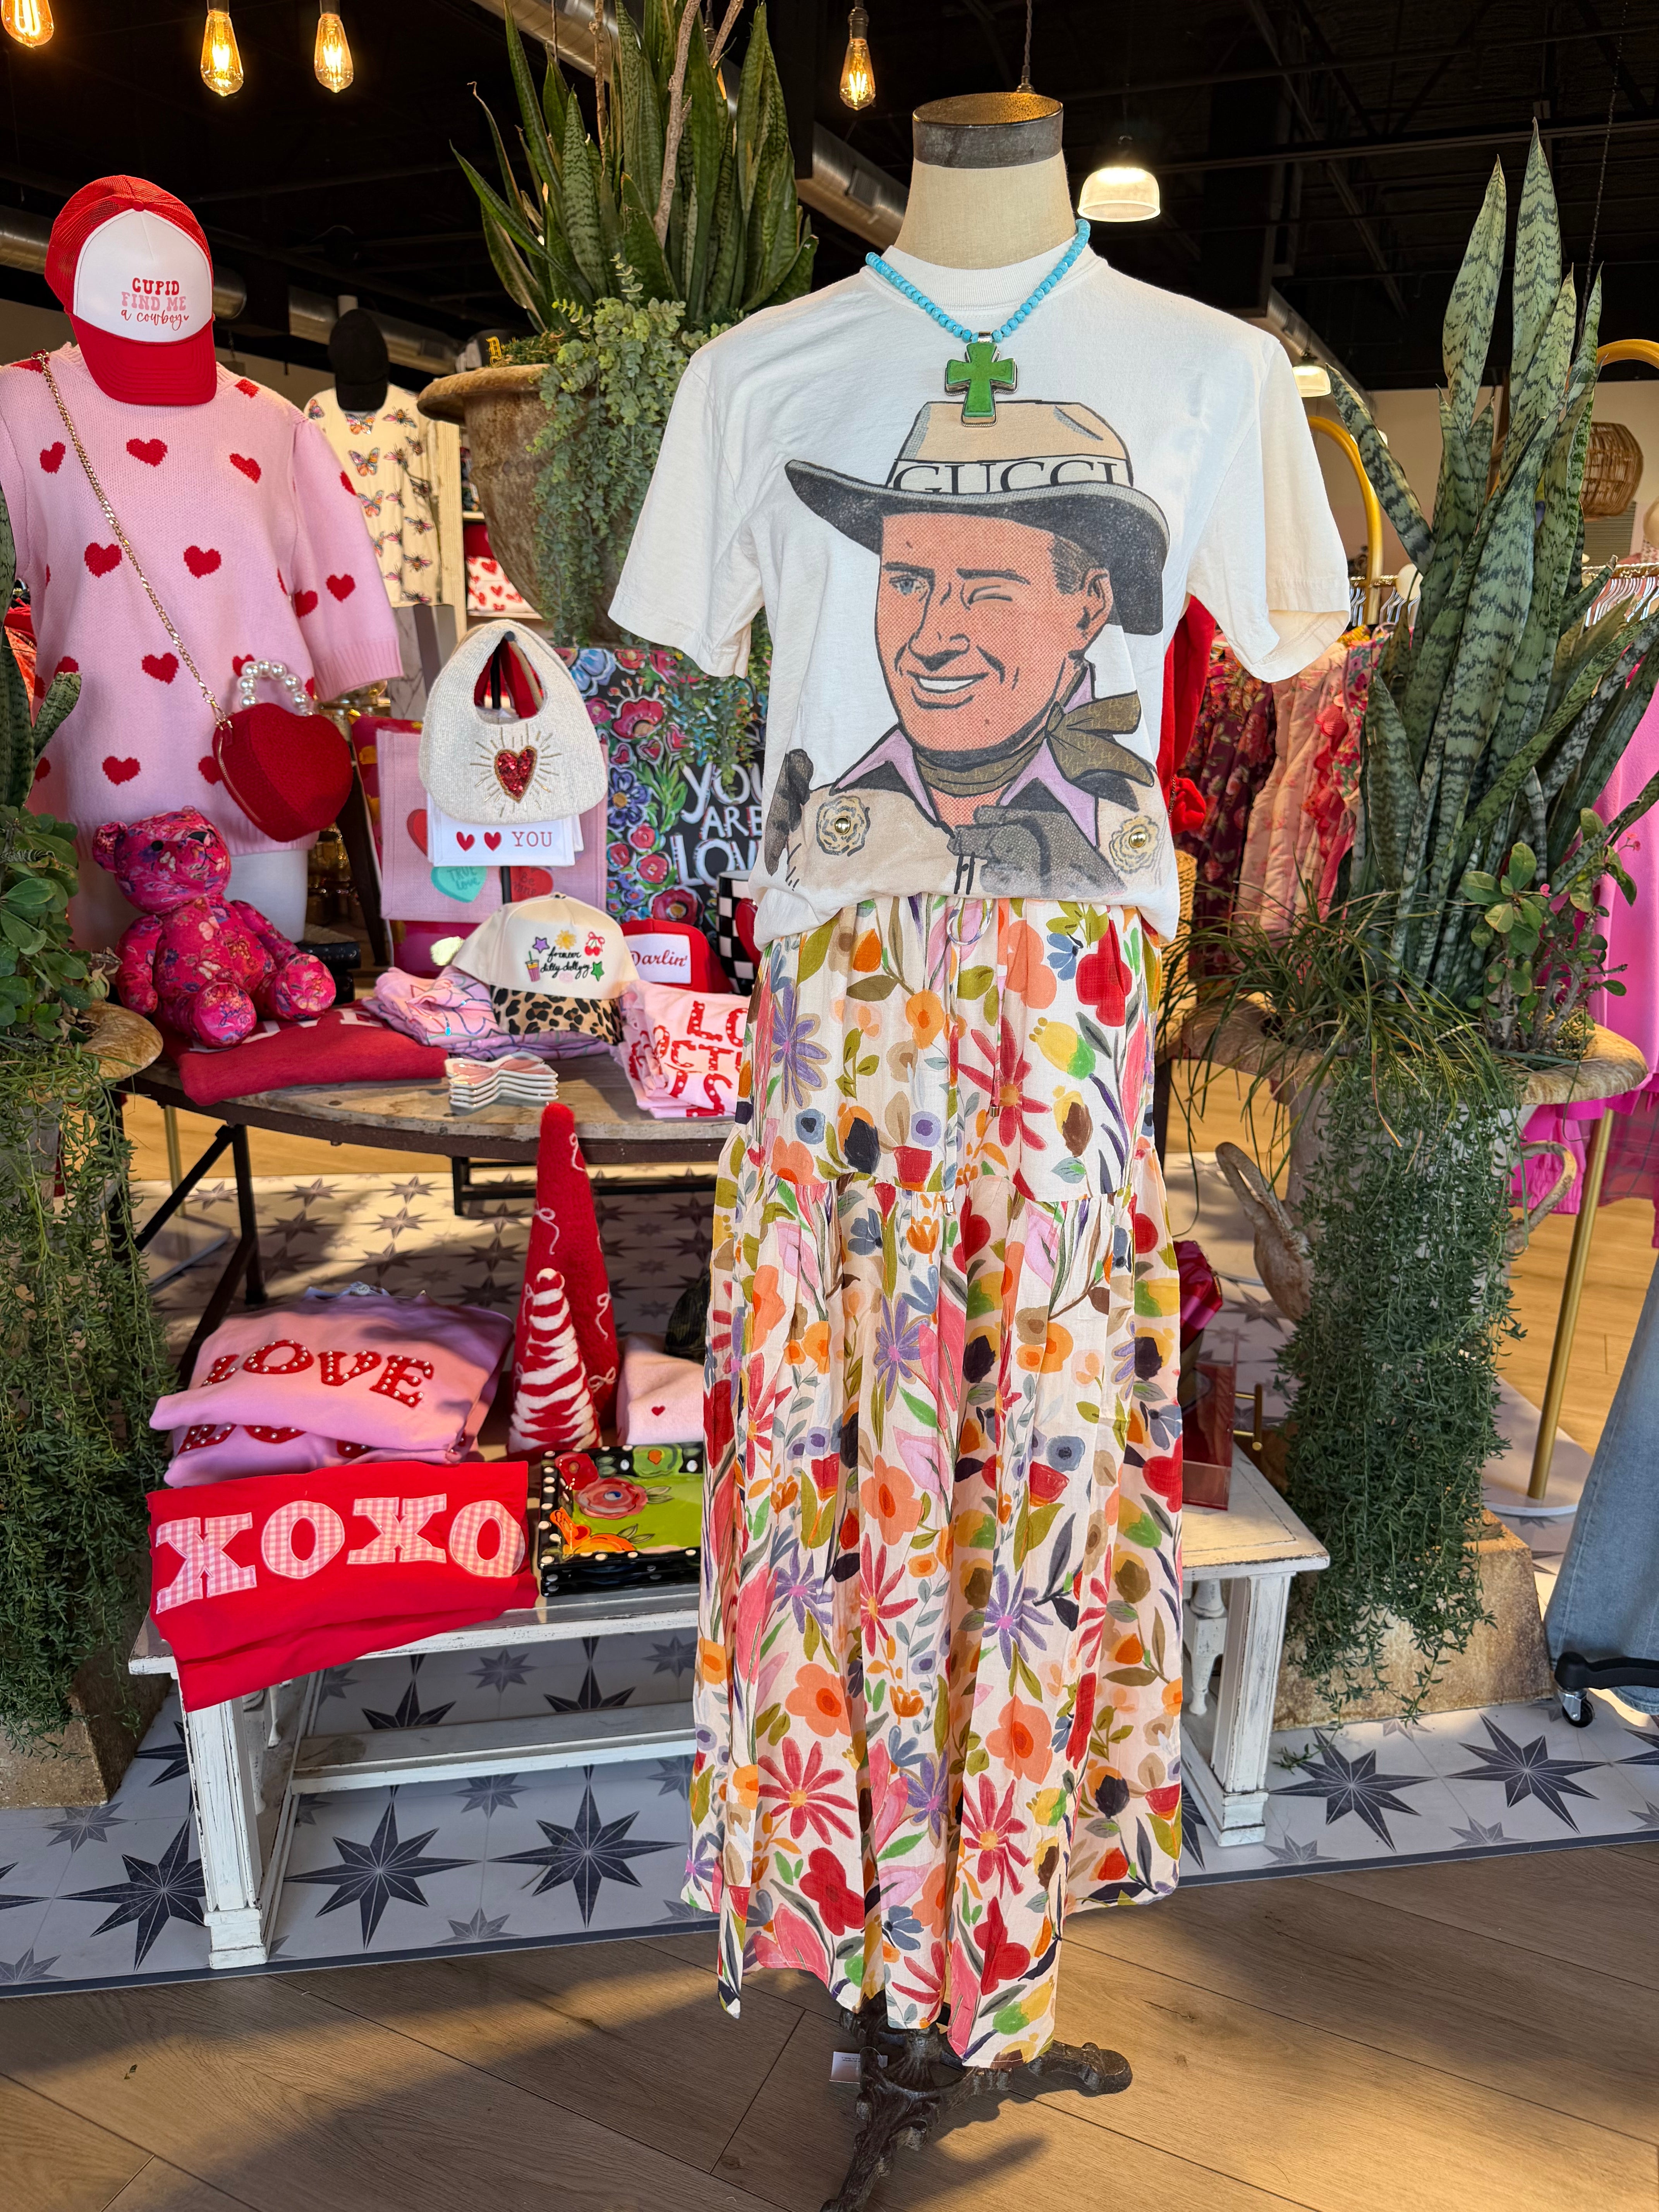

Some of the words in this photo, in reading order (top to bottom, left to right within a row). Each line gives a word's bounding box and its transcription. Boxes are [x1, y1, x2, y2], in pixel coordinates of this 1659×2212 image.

[132, 277, 180, 296] CUPID
[121, 291, 160, 311] FIND
[166, 296, 186, 312] ME
[121, 309, 132, 321] a
[137, 309, 183, 331] cowboy
[512, 831, 553, 847] YOU
[630, 949, 688, 967] Darlin'
[199, 1339, 435, 1408] LOVE
[155, 1493, 526, 1614] XOXO
